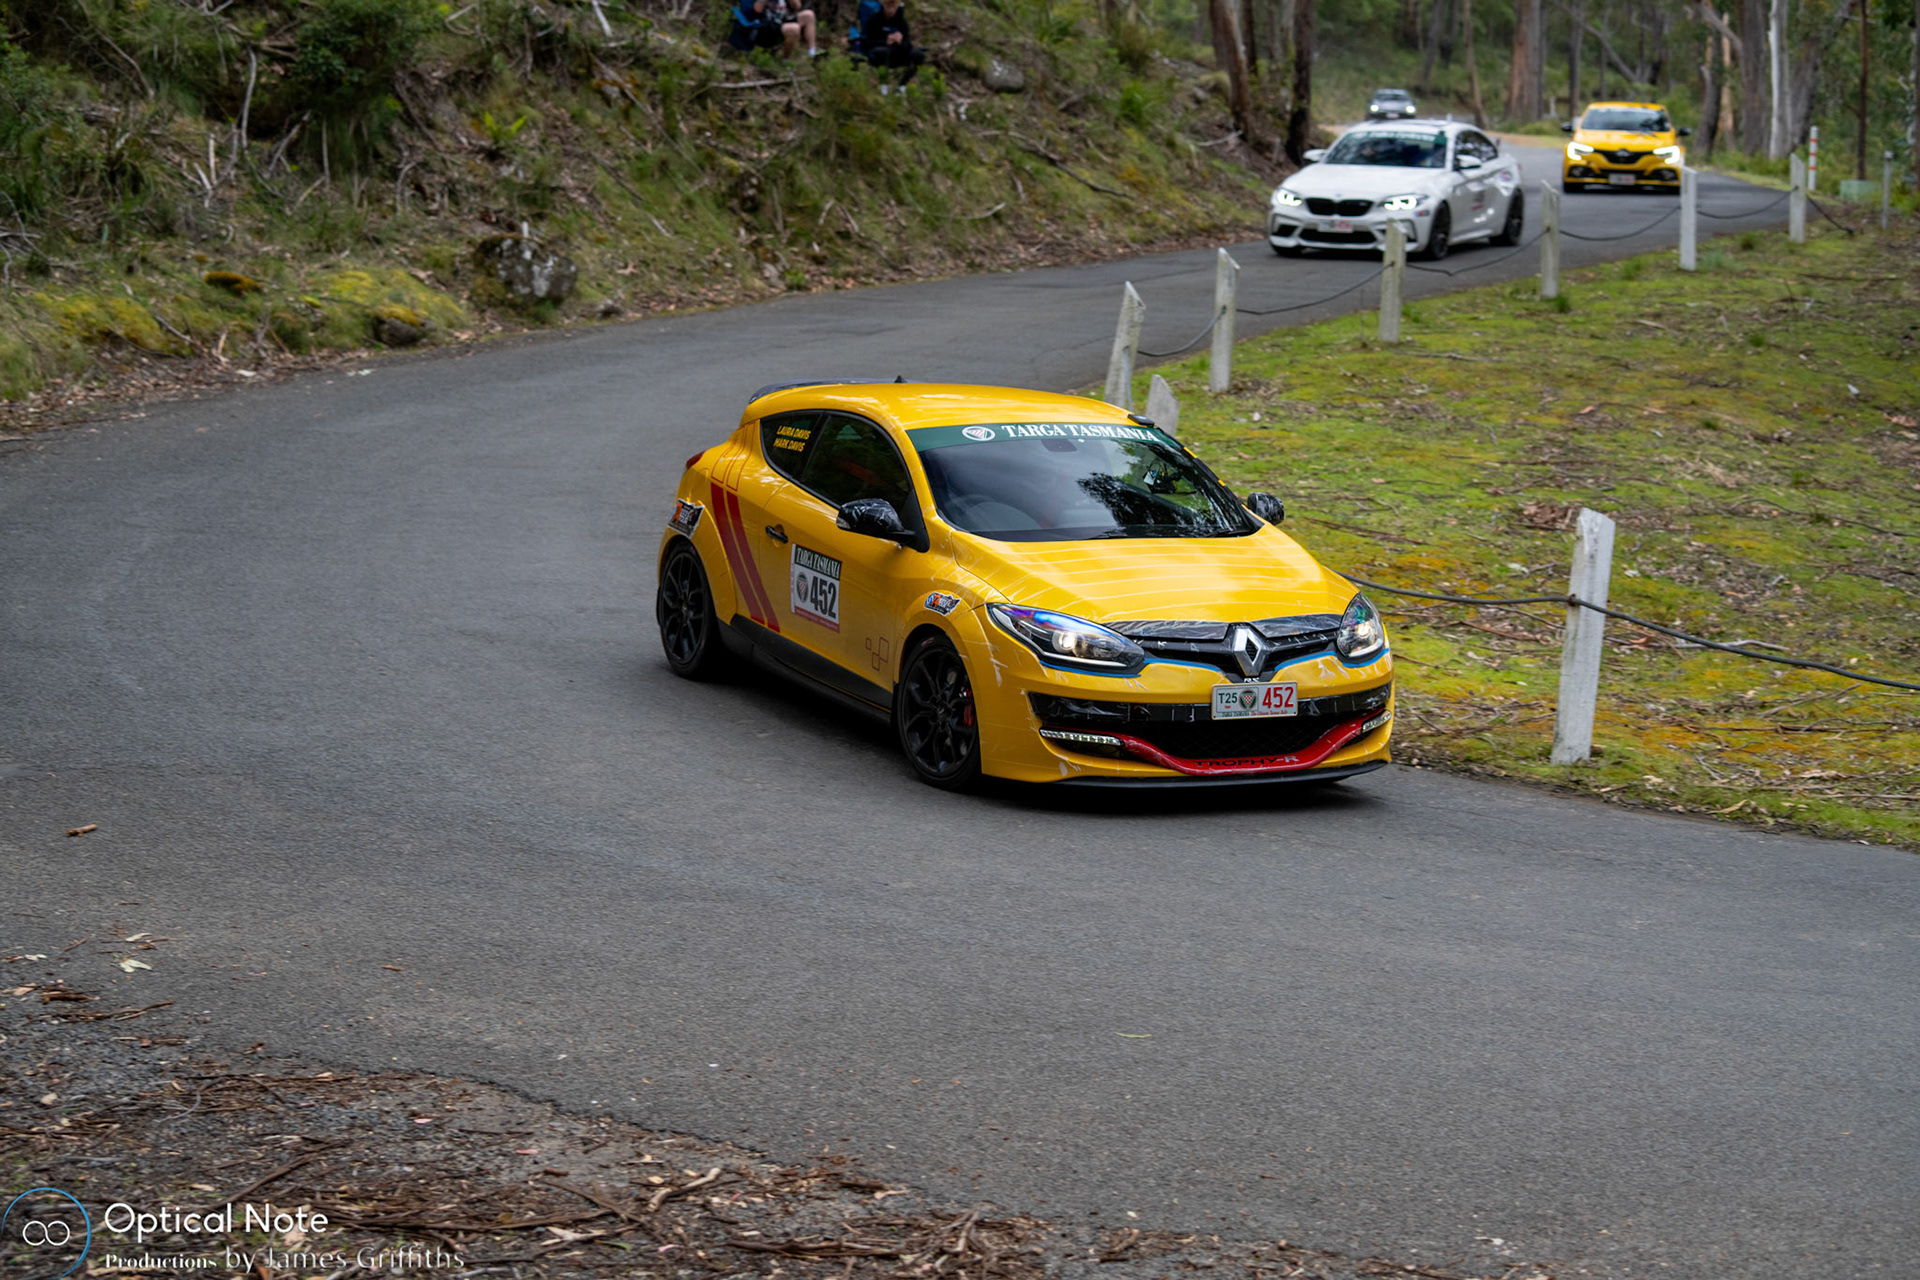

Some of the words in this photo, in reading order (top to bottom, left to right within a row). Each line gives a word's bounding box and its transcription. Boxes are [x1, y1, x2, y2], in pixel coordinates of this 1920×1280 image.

[777, 425, 795, 437] LAURA
[793, 428, 811, 440] DAVIS
[1001, 424, 1067, 438] TARGA
[1064, 424, 1161, 443] TASMANIA
[773, 437, 790, 449] MARK
[787, 440, 805, 452] DAVIS
[810, 575, 837, 619] 452
[1218, 692, 1238, 704] T25
[1262, 686, 1294, 709] 452
[1194, 756, 1299, 767] TROPHY-R
